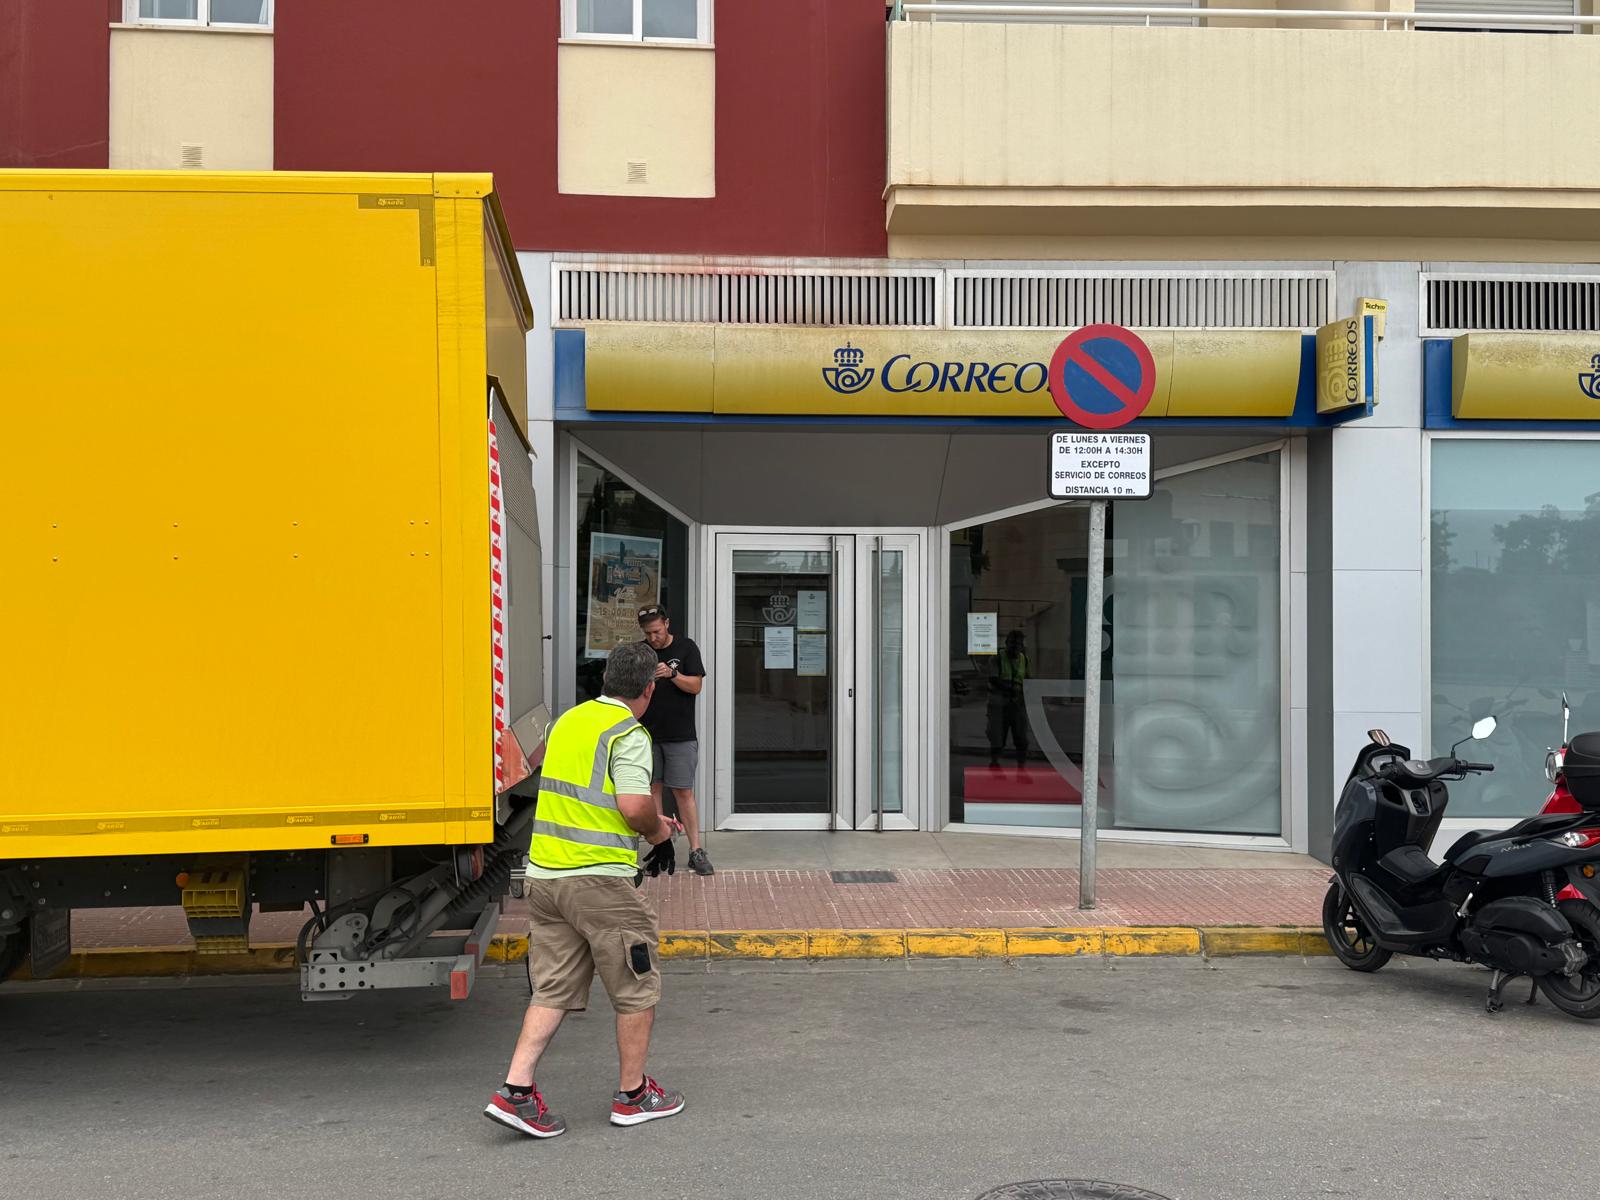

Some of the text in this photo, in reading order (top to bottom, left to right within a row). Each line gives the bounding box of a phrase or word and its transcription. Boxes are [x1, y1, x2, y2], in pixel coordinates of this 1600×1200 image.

[1346, 320, 1358, 403] CORREOS
[881, 354, 1051, 393] CORREO
[1056, 435, 1146, 443] DE LUNES A VIERNES
[1059, 446, 1070, 454] DE
[1074, 446, 1102, 454] 12:00H
[1081, 460, 1120, 468] EXCEPTO
[1055, 471, 1146, 480] SERVICIO DE CORREOS
[1065, 486, 1109, 494] DISTANCIA
[1113, 486, 1122, 494] 10
